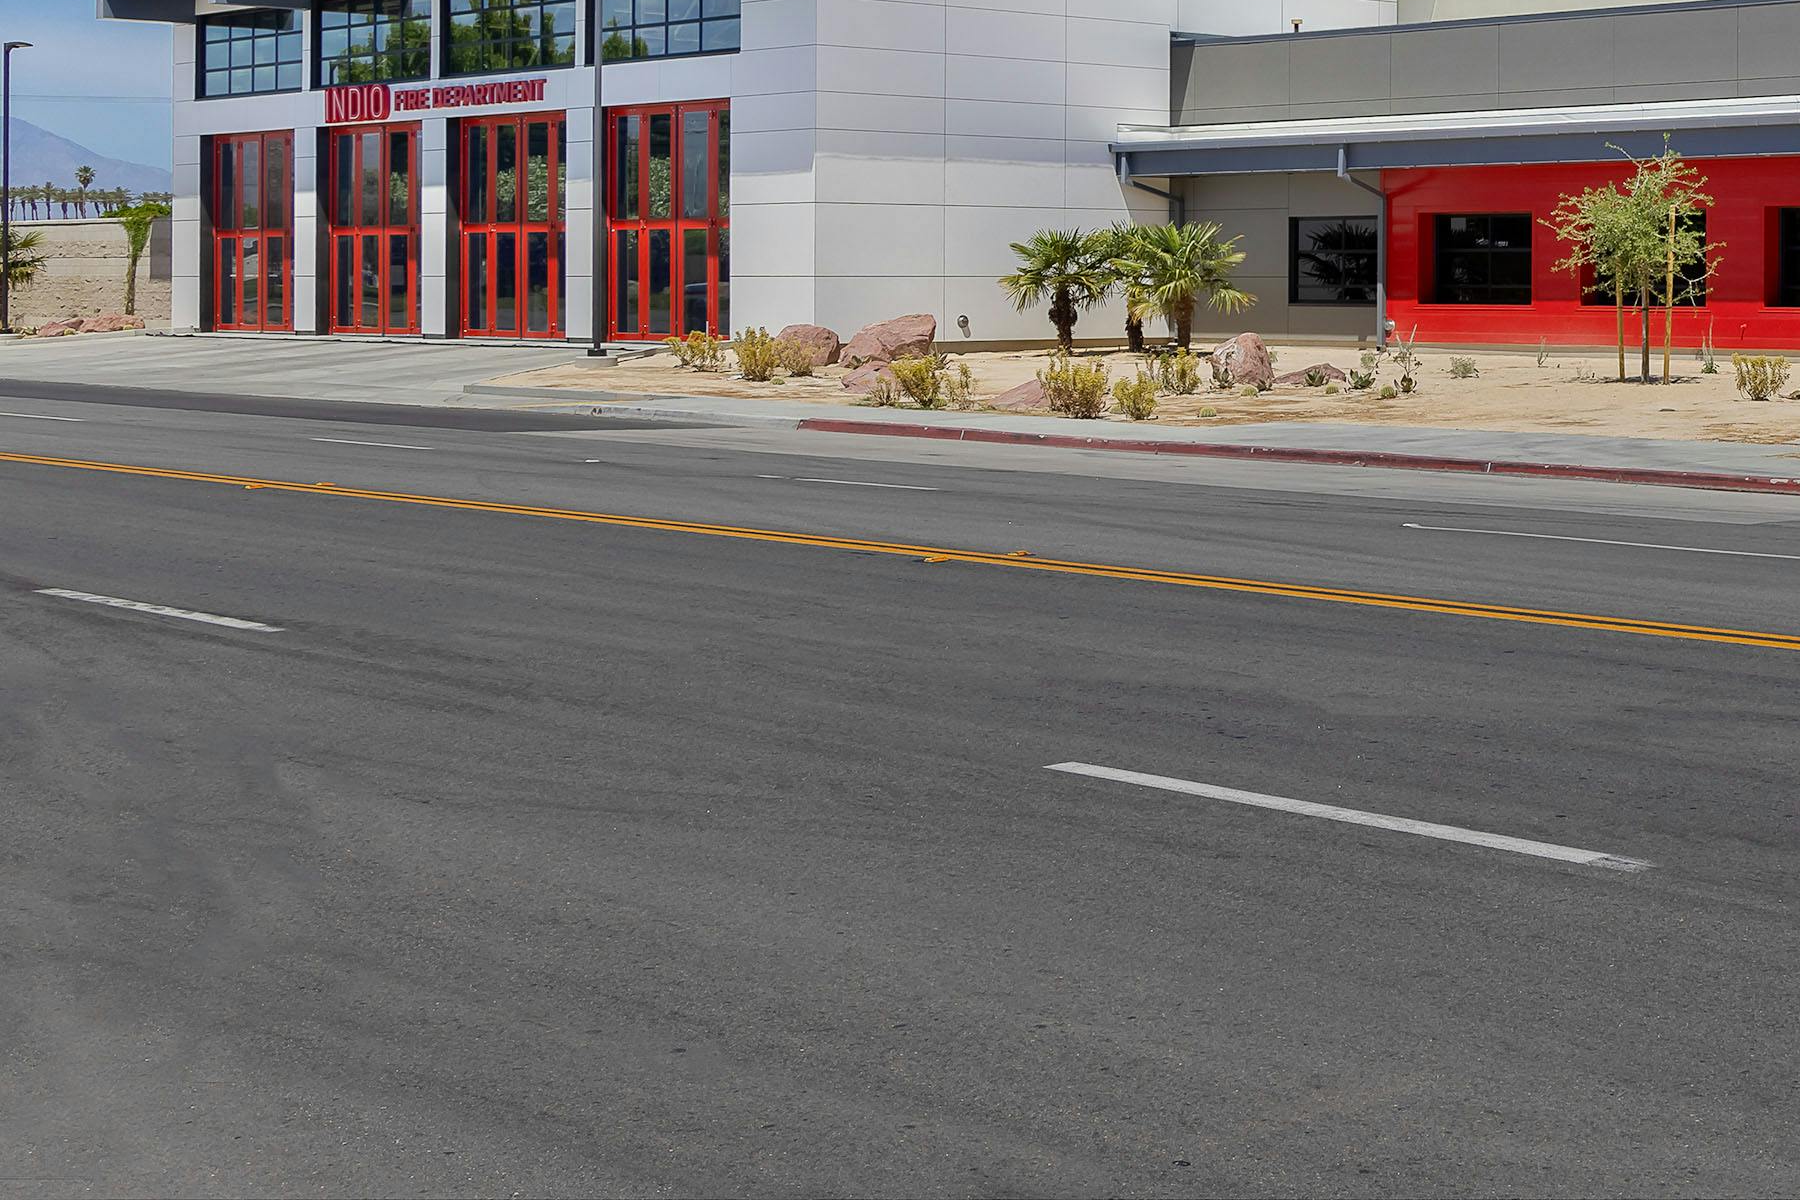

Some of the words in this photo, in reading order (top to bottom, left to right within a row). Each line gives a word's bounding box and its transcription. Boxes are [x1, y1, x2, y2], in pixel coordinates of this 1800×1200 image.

[325, 84, 386, 122] INDIO
[395, 88, 430, 111] FIRE
[432, 79, 547, 108] DEPARTMENT
